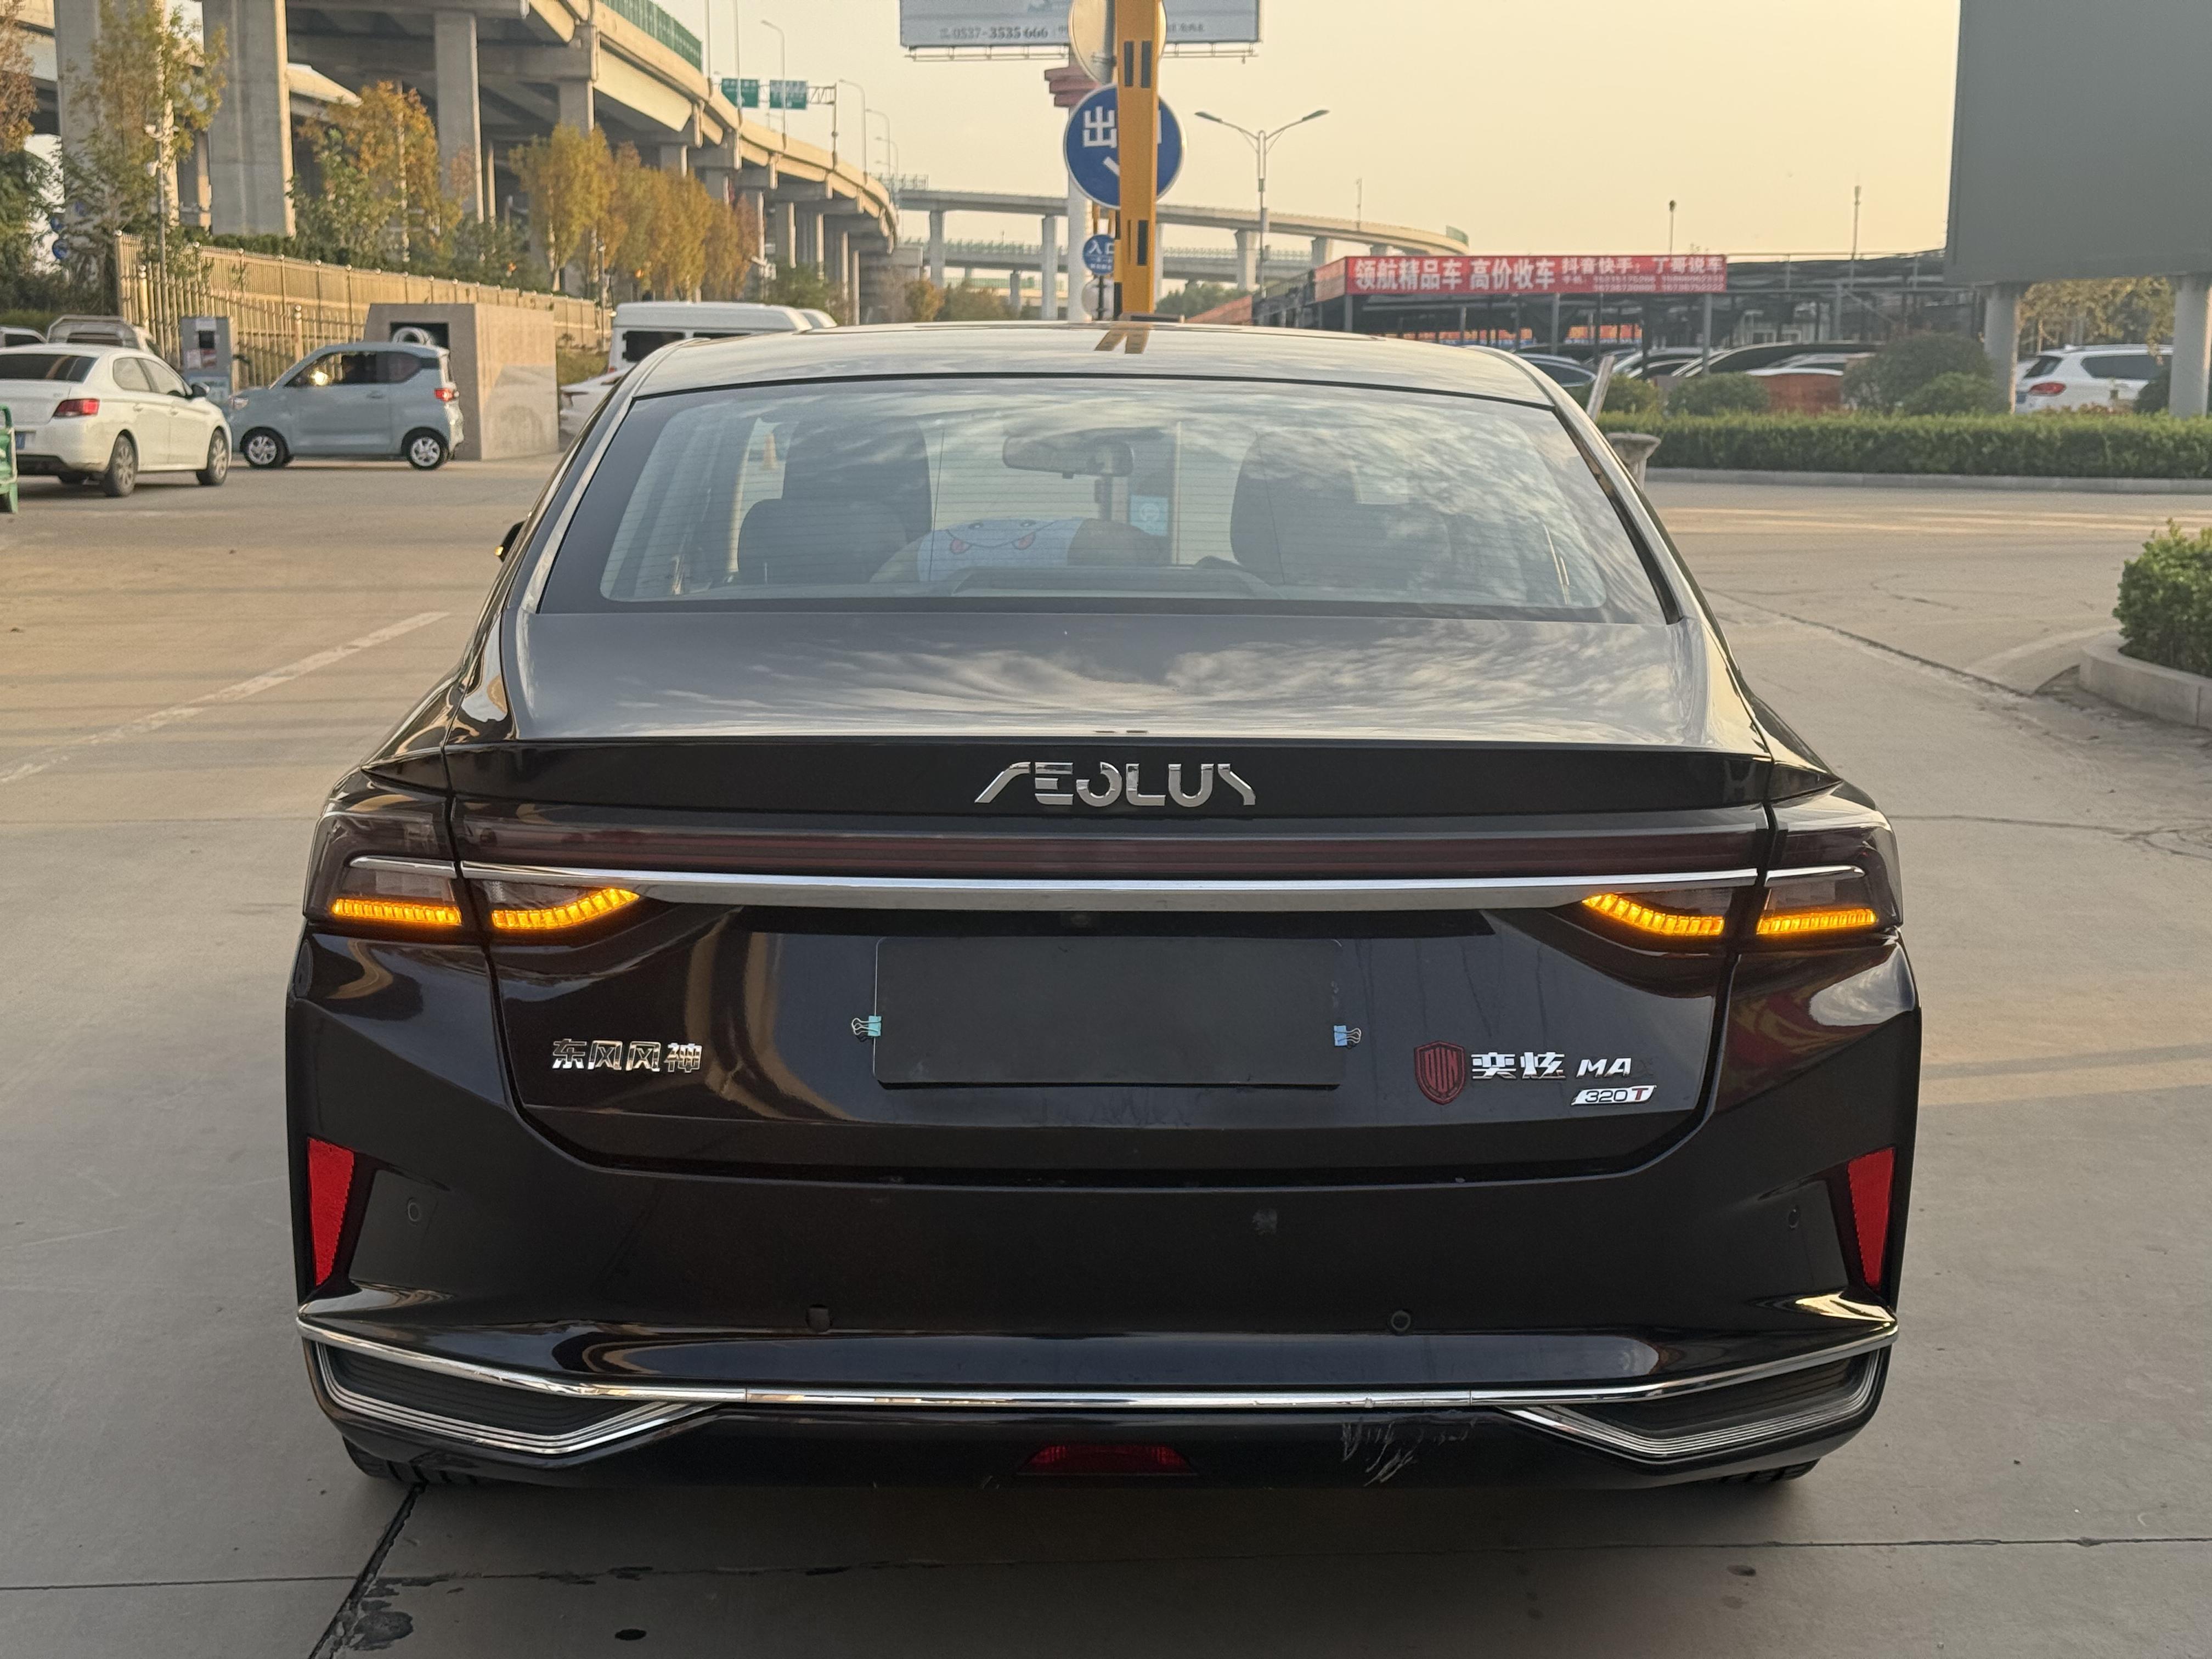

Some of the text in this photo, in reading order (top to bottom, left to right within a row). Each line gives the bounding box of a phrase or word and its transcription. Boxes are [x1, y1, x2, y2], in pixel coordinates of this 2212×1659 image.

[1355, 258, 1463, 290] 领航精品车
[1470, 258, 1555, 290] 高价收车
[552, 1038, 703, 1073] 东风风神
[1471, 1051, 1566, 1080] 奕炫
[1584, 1087, 1649, 1103] 320T
